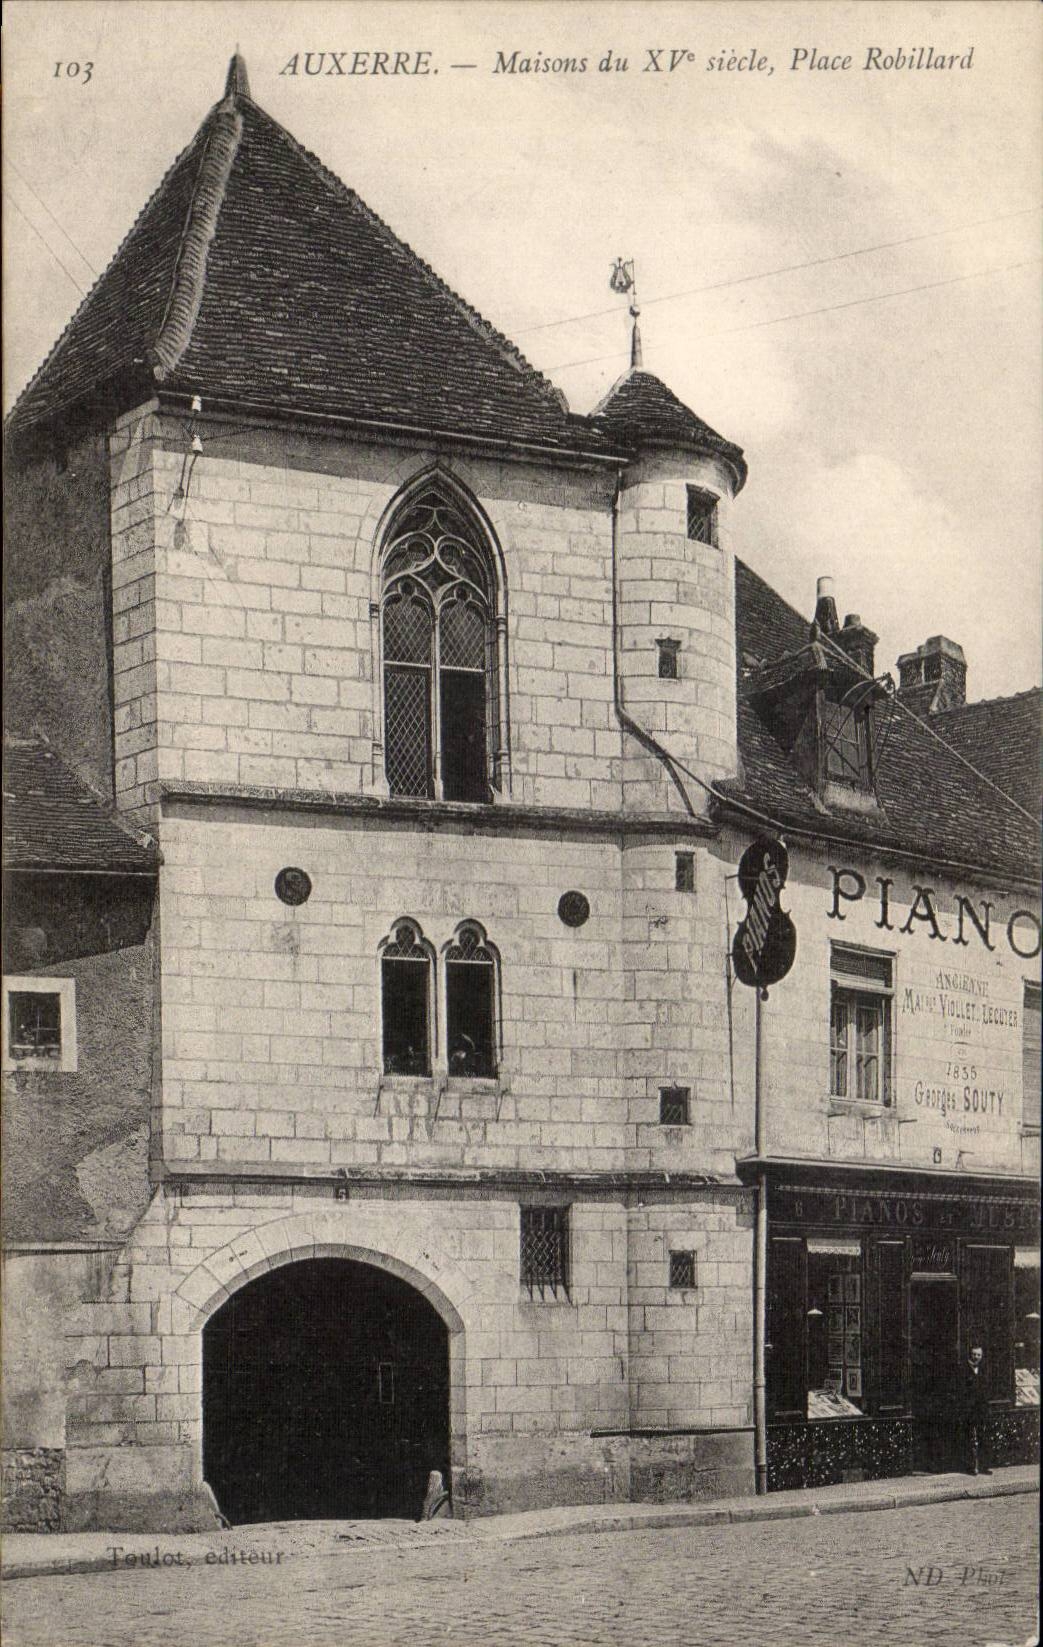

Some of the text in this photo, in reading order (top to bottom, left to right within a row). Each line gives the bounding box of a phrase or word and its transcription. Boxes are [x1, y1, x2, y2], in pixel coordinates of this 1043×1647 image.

[742, 851, 780, 976] PIANOS
[826, 865, 1041, 959] PIANO
[936, 969, 989, 998] ANCIENNE
[963, 1086, 1004, 1116] SOUTY
[337, 1187, 347, 1201] 5
[834, 1195, 924, 1226] PIANOS
